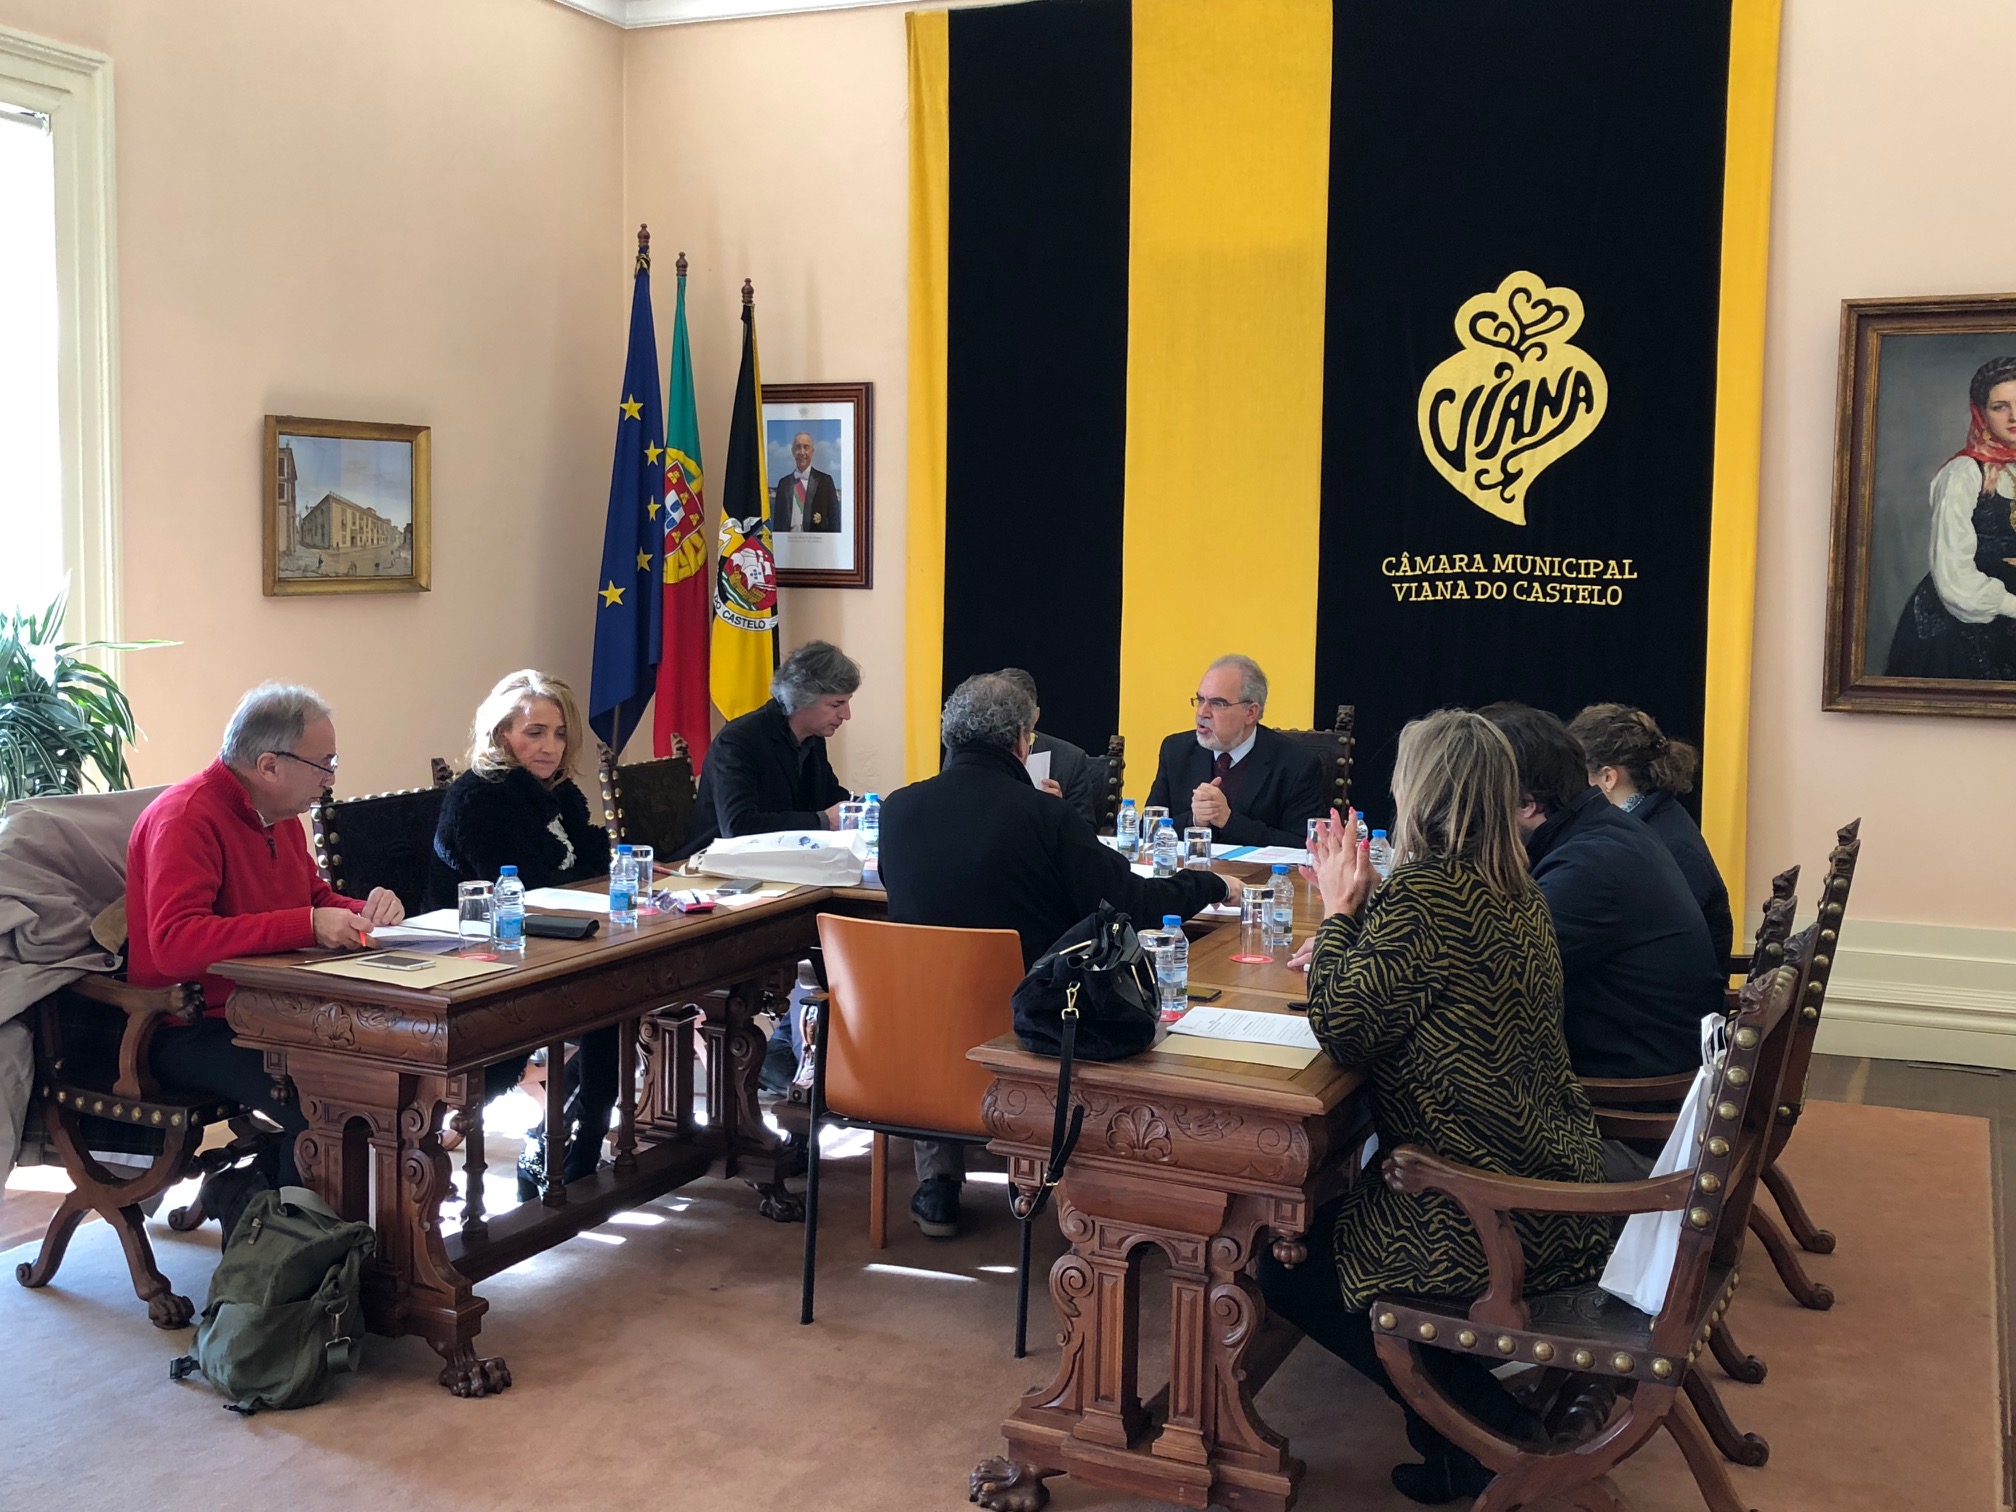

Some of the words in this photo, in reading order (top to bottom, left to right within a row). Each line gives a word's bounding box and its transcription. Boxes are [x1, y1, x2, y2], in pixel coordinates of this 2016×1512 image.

[1428, 362, 1595, 474] VIANA
[1381, 551, 1488, 577] CÂMARA
[1491, 553, 1638, 580] MUNICIPAL
[1391, 579, 1471, 602] VIANA
[1474, 580, 1508, 600] DO
[1512, 581, 1623, 606] CASTELO
[722, 610, 766, 630] CASTELO
